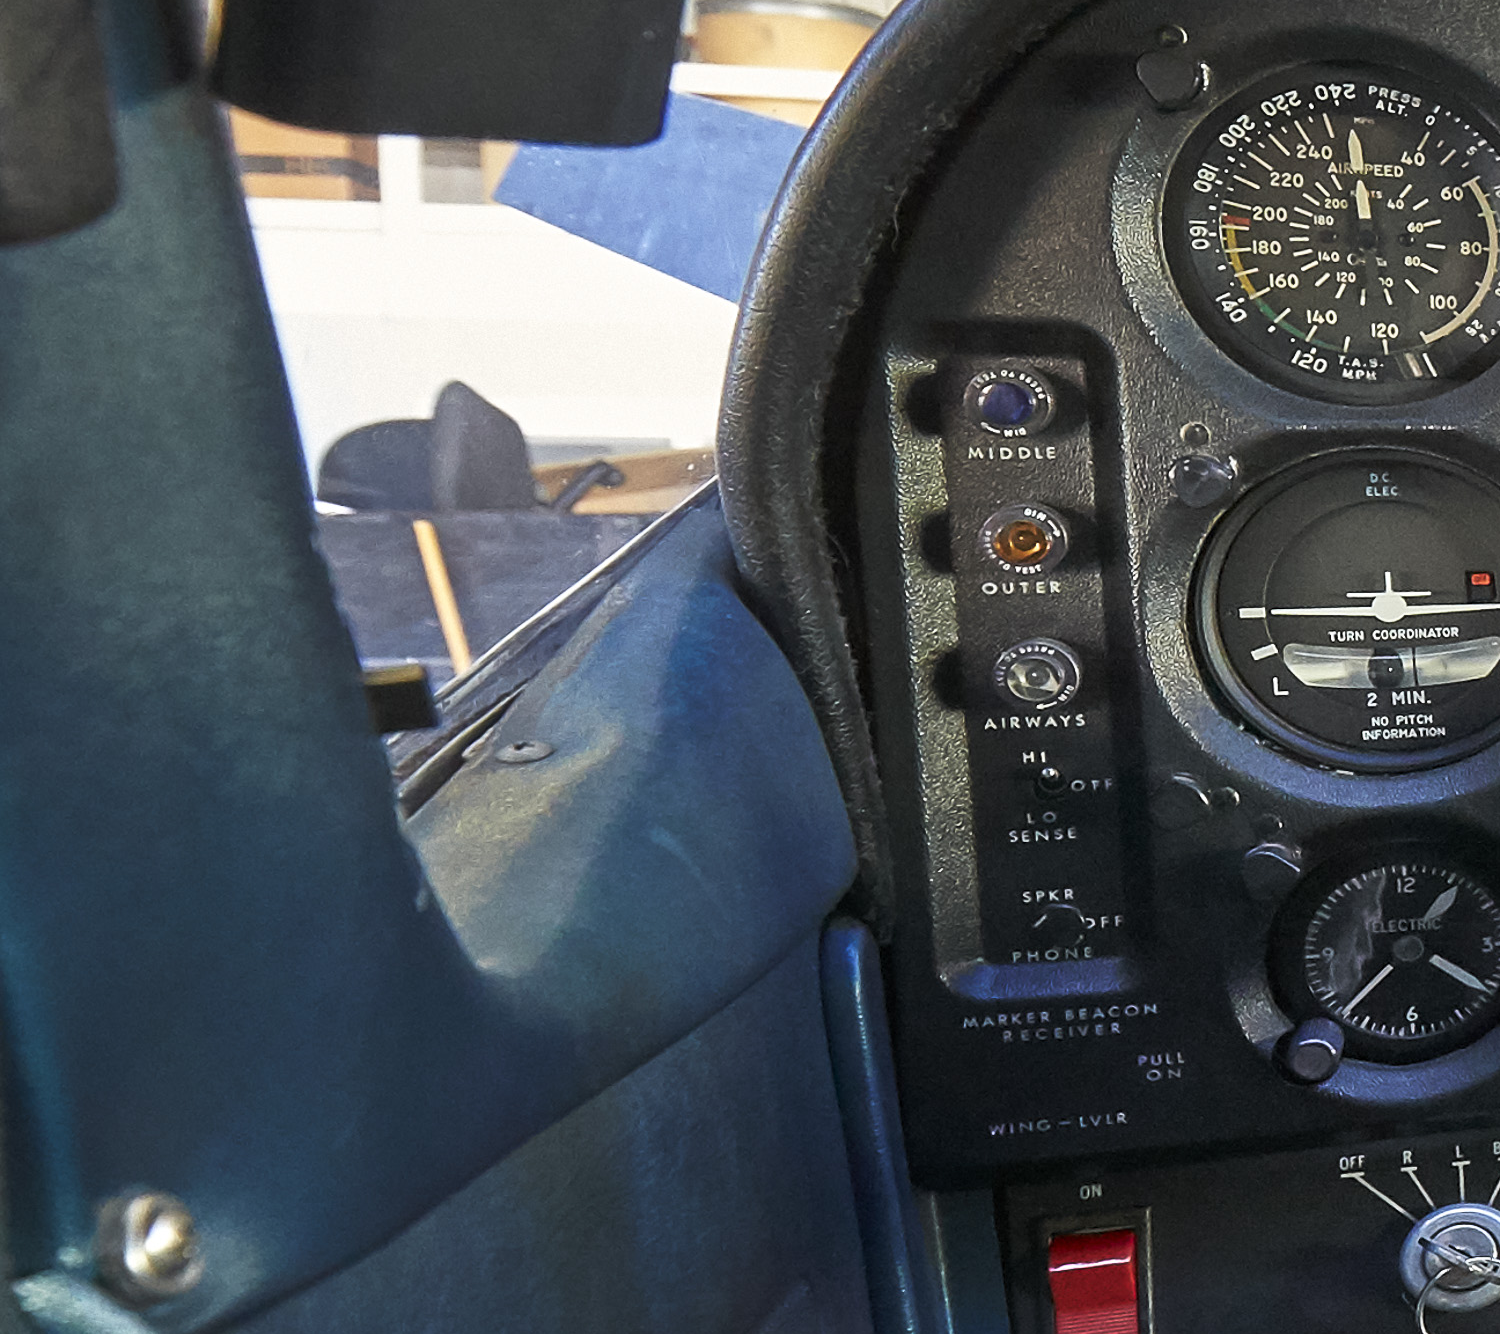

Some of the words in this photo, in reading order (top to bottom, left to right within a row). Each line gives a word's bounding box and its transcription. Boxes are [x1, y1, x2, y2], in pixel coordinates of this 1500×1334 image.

[1368, 85, 1421, 108] PRESS
[1296, 145, 1333, 160] 240
[1400, 152, 1426, 167] 40
[1270, 172, 1304, 188] 220
[1440, 187, 1464, 201] 60
[1252, 206, 1288, 222] 200
[1252, 240, 1282, 256] 180
[1460, 241, 1482, 256] 80
[1269, 273, 1299, 289] 160
[1429, 295, 1457, 310] 100
[1307, 309, 1338, 325] 140
[1371, 323, 1399, 338] 120
[968, 446, 1057, 460] MIDDLE
[981, 581, 1062, 596] OUTER
[1328, 629, 1365, 642] TURN
[1372, 626, 1459, 640] COORDINATOR
[984, 713, 1087, 730] AIRWAYS
[1395, 714, 1434, 726] PITCH
[1361, 726, 1447, 741] INFORMATION
[1070, 778, 1114, 792] OFF
[1008, 827, 1077, 843] SENSE
[1022, 888, 1075, 903] SPKR
[1372, 917, 1441, 934] ELECTRIC
[1011, 946, 1095, 964] PHONE
[963, 1010, 1051, 1030] MARKER
[1065, 1003, 1160, 1022] BEACON
[1003, 1022, 1122, 1043] RECEIVER
[1137, 1052, 1185, 1067] PULL
[1146, 1068, 1183, 1082] ON
[989, 1118, 1052, 1136] WING
[1079, 1112, 1129, 1129] LVLR
[1339, 1154, 1365, 1171] OFF
